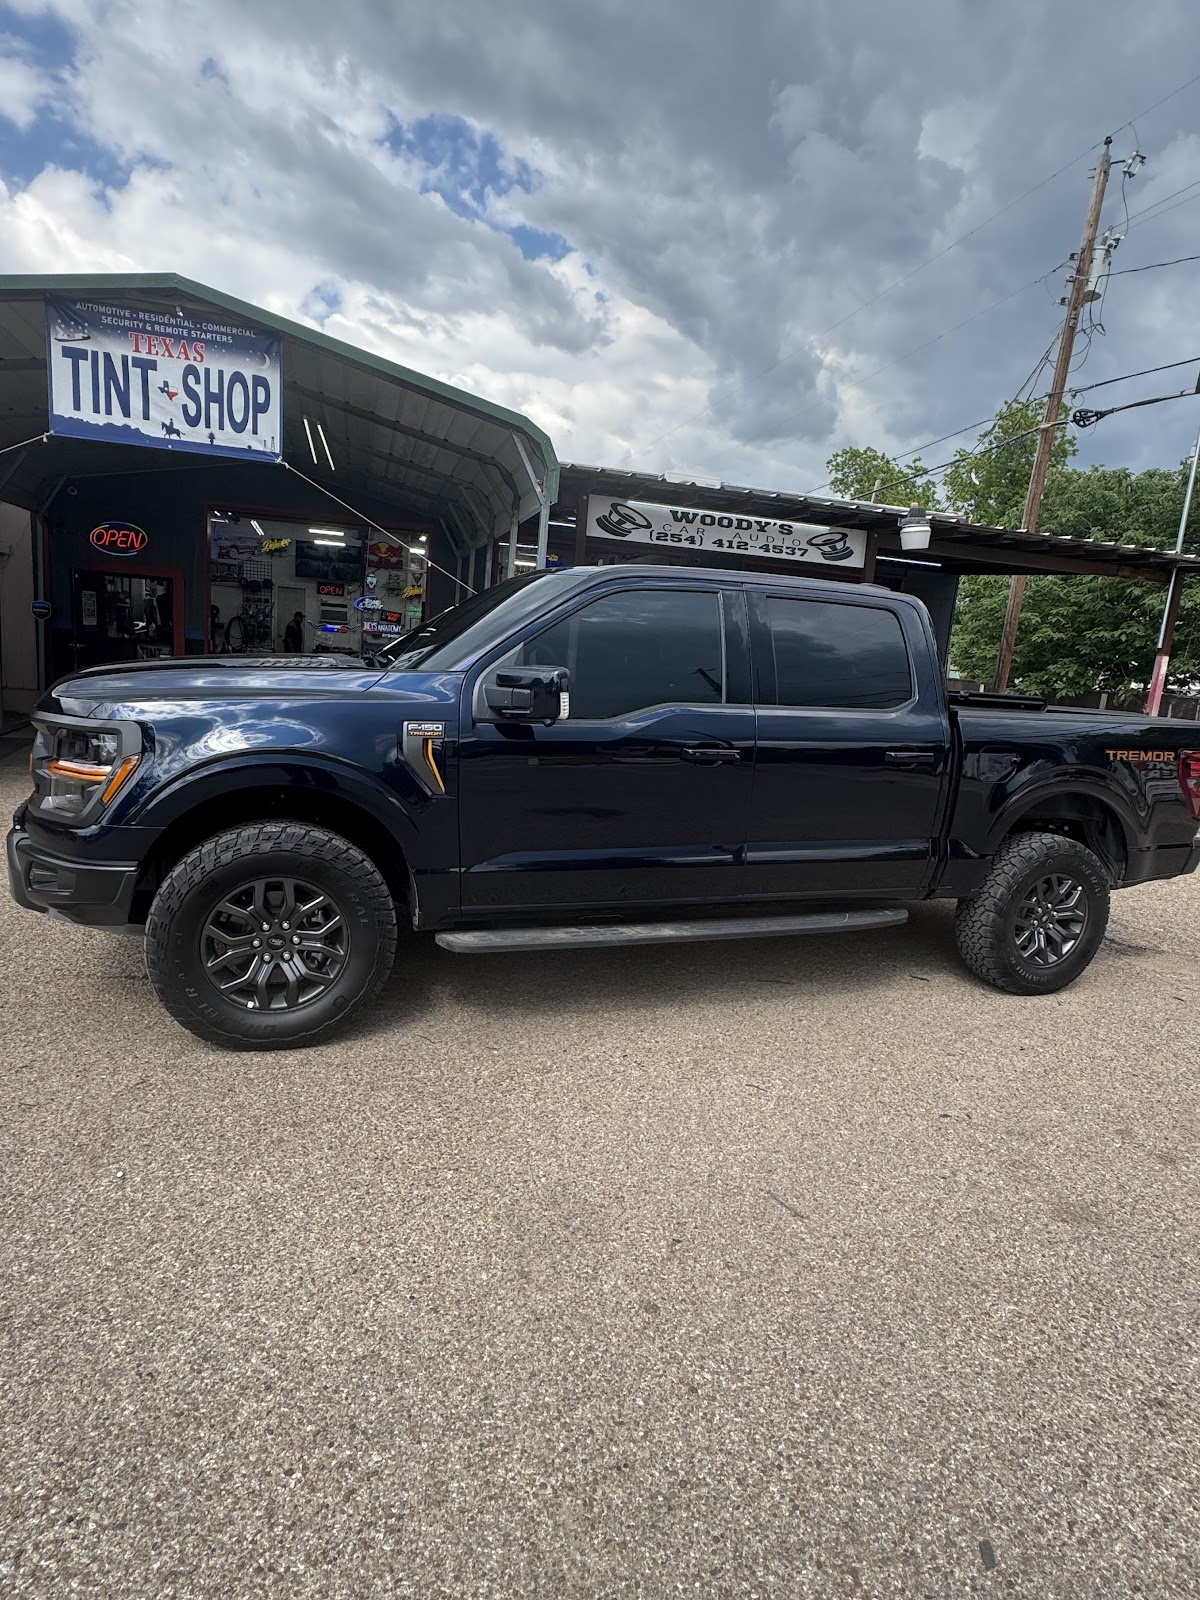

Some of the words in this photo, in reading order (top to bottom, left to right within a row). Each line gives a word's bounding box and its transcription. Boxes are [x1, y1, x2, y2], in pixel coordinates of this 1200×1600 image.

[75, 301, 131, 318] AUTOMOTIVE
[138, 312, 195, 328] RESIDENTIAL
[202, 322, 256, 338] COMMERCIAL
[101, 315, 143, 329] SECURITY
[146, 323, 153, 331] &
[154, 324, 188, 337] REMOTE
[190, 330, 233, 344] STARTERS
[128, 331, 206, 363] TEXAS
[61, 345, 158, 421] TINT
[181, 363, 271, 436] SHOP
[662, 523, 706, 537] CAR
[732, 532, 802, 547] AUDIO
[669, 509, 794, 536] WOODY'S
[93, 529, 143, 548] OPEN
[649, 528, 704, 547] (254)
[711, 538, 809, 558] 412-4537
[319, 585, 343, 595] OPEN
[1105, 750, 1175, 761] TREMOR
